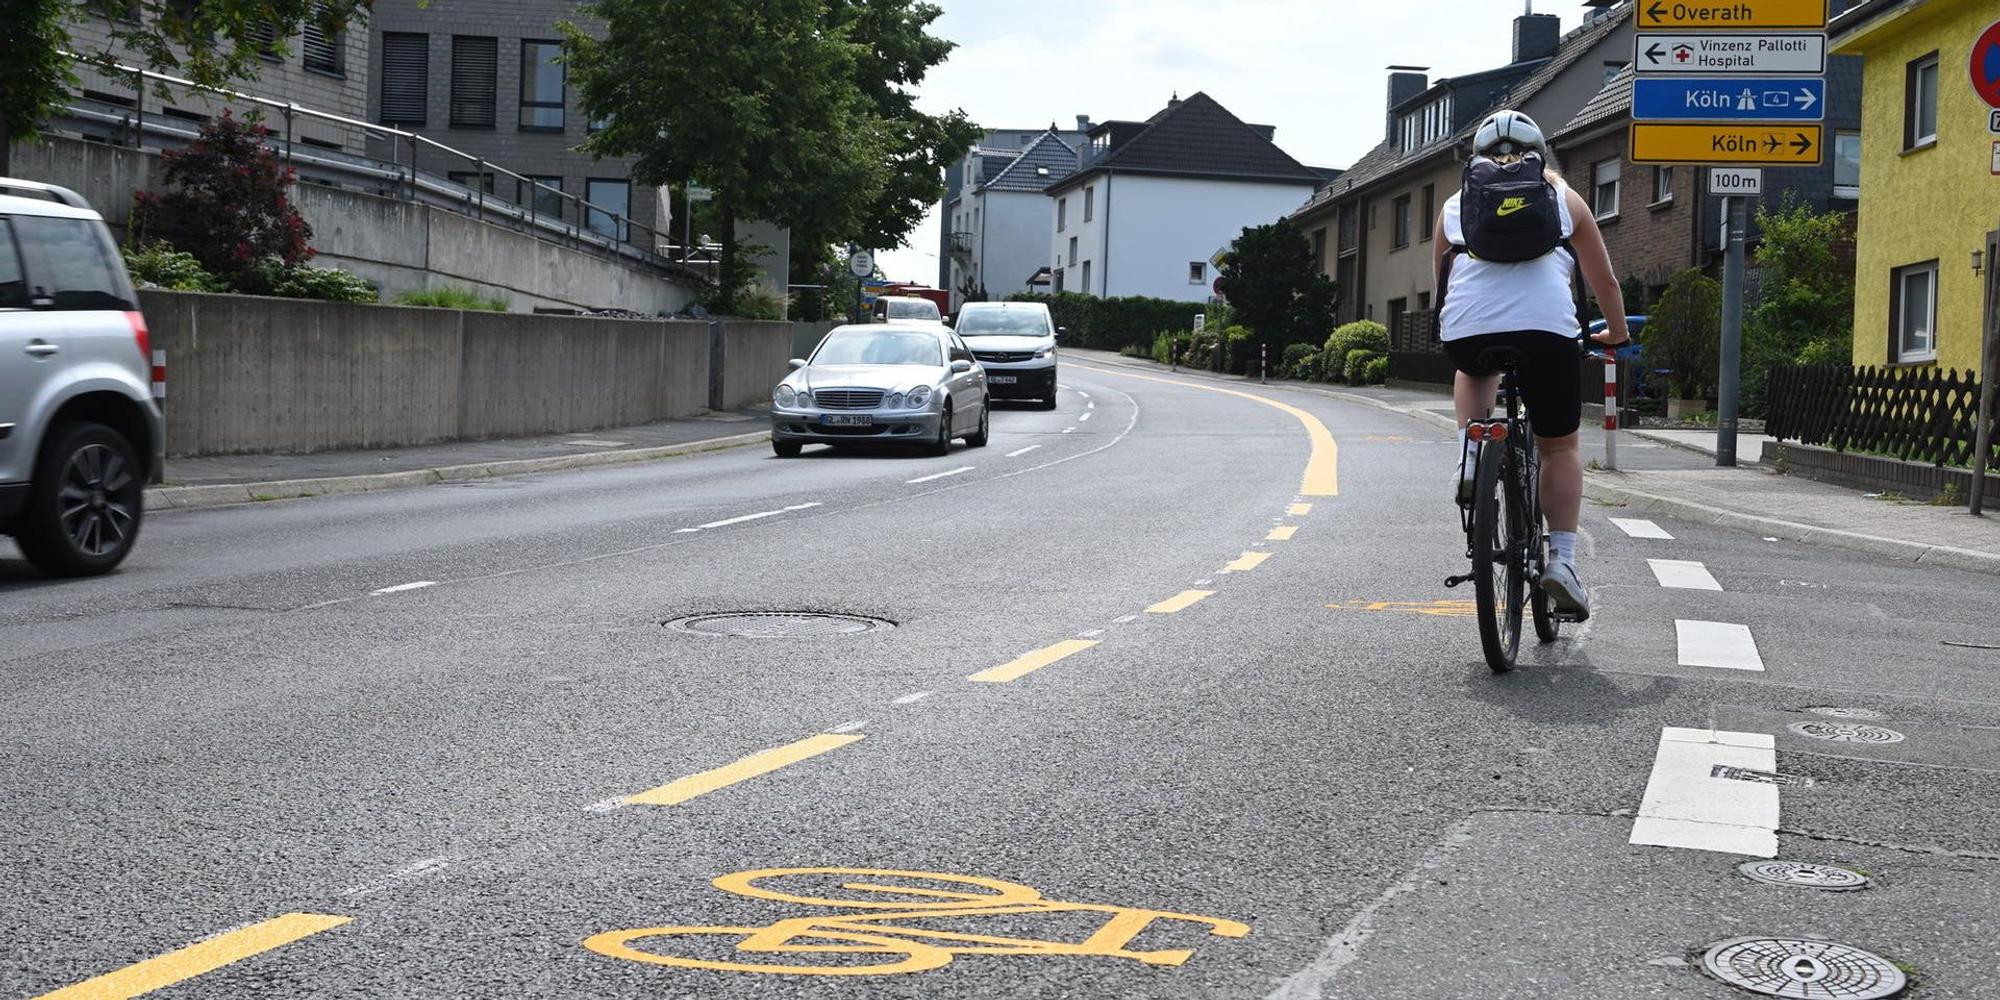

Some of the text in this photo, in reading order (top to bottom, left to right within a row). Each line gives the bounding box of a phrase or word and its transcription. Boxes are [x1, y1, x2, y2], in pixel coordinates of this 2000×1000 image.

[1673, 3, 1752, 20] Overath
[1700, 39, 1807, 52] Vinzenz Pallotti
[1698, 54, 1754, 69] Hospital
[1686, 89, 1780, 108] Köln 4
[1712, 134, 1757, 152] Köln
[1502, 197, 1525, 208] NIKE
